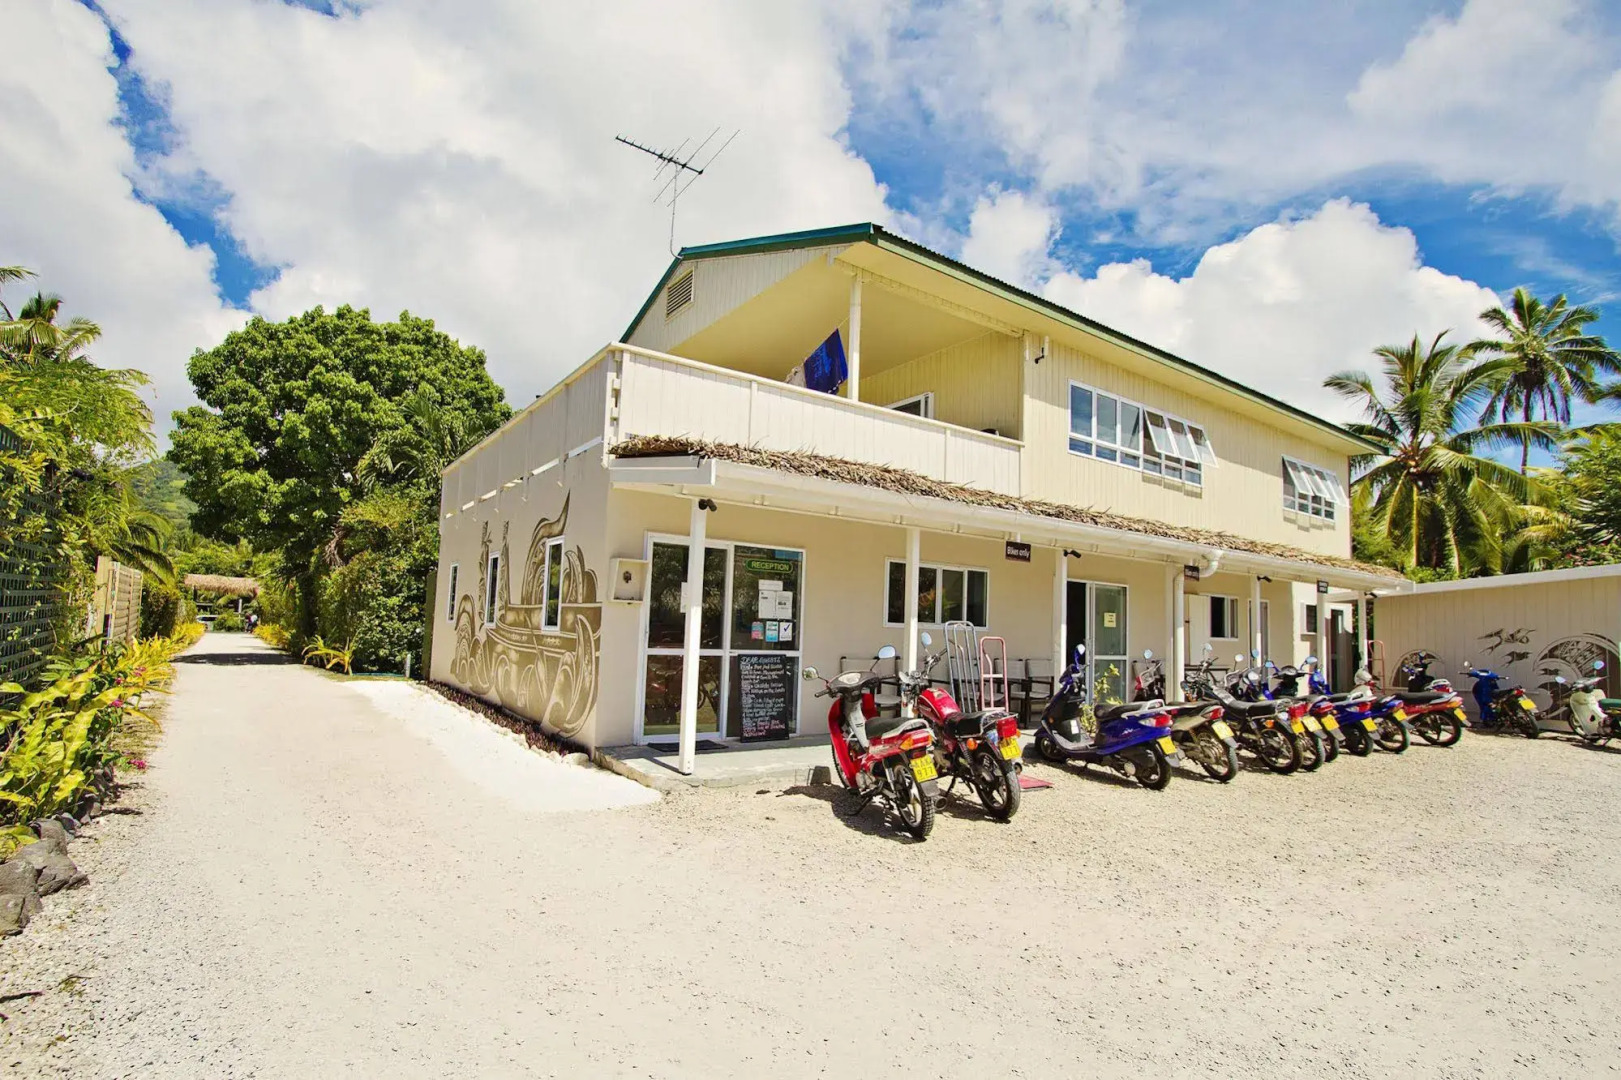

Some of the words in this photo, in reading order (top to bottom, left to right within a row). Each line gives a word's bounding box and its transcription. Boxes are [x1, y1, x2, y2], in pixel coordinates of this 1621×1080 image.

[1007, 546, 1018, 555] Bikes
[1019, 548, 1030, 559] only
[751, 561, 790, 571] RECEPTION
[740, 656, 758, 664] DEAR
[916, 766, 933, 778] 977
